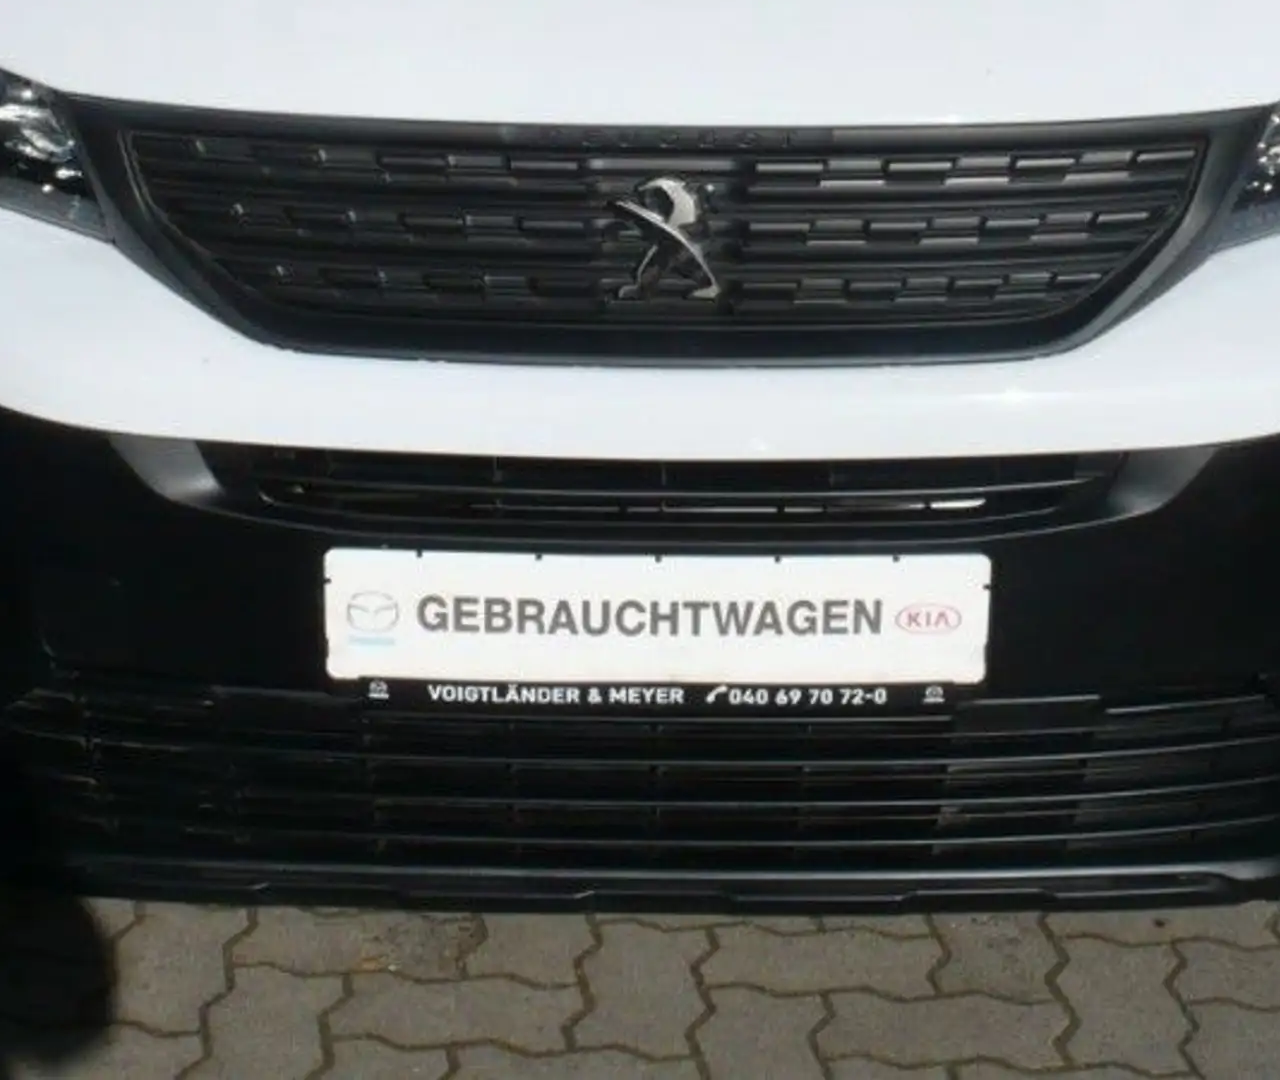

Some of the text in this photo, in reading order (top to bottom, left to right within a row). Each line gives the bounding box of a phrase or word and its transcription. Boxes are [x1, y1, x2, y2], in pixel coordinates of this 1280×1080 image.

[416, 594, 951, 637] GEBRAUCHTWAGEN KIA
[427, 683, 887, 705] VOIGTLÄNDER & MEYER 040 69 70 72-0
